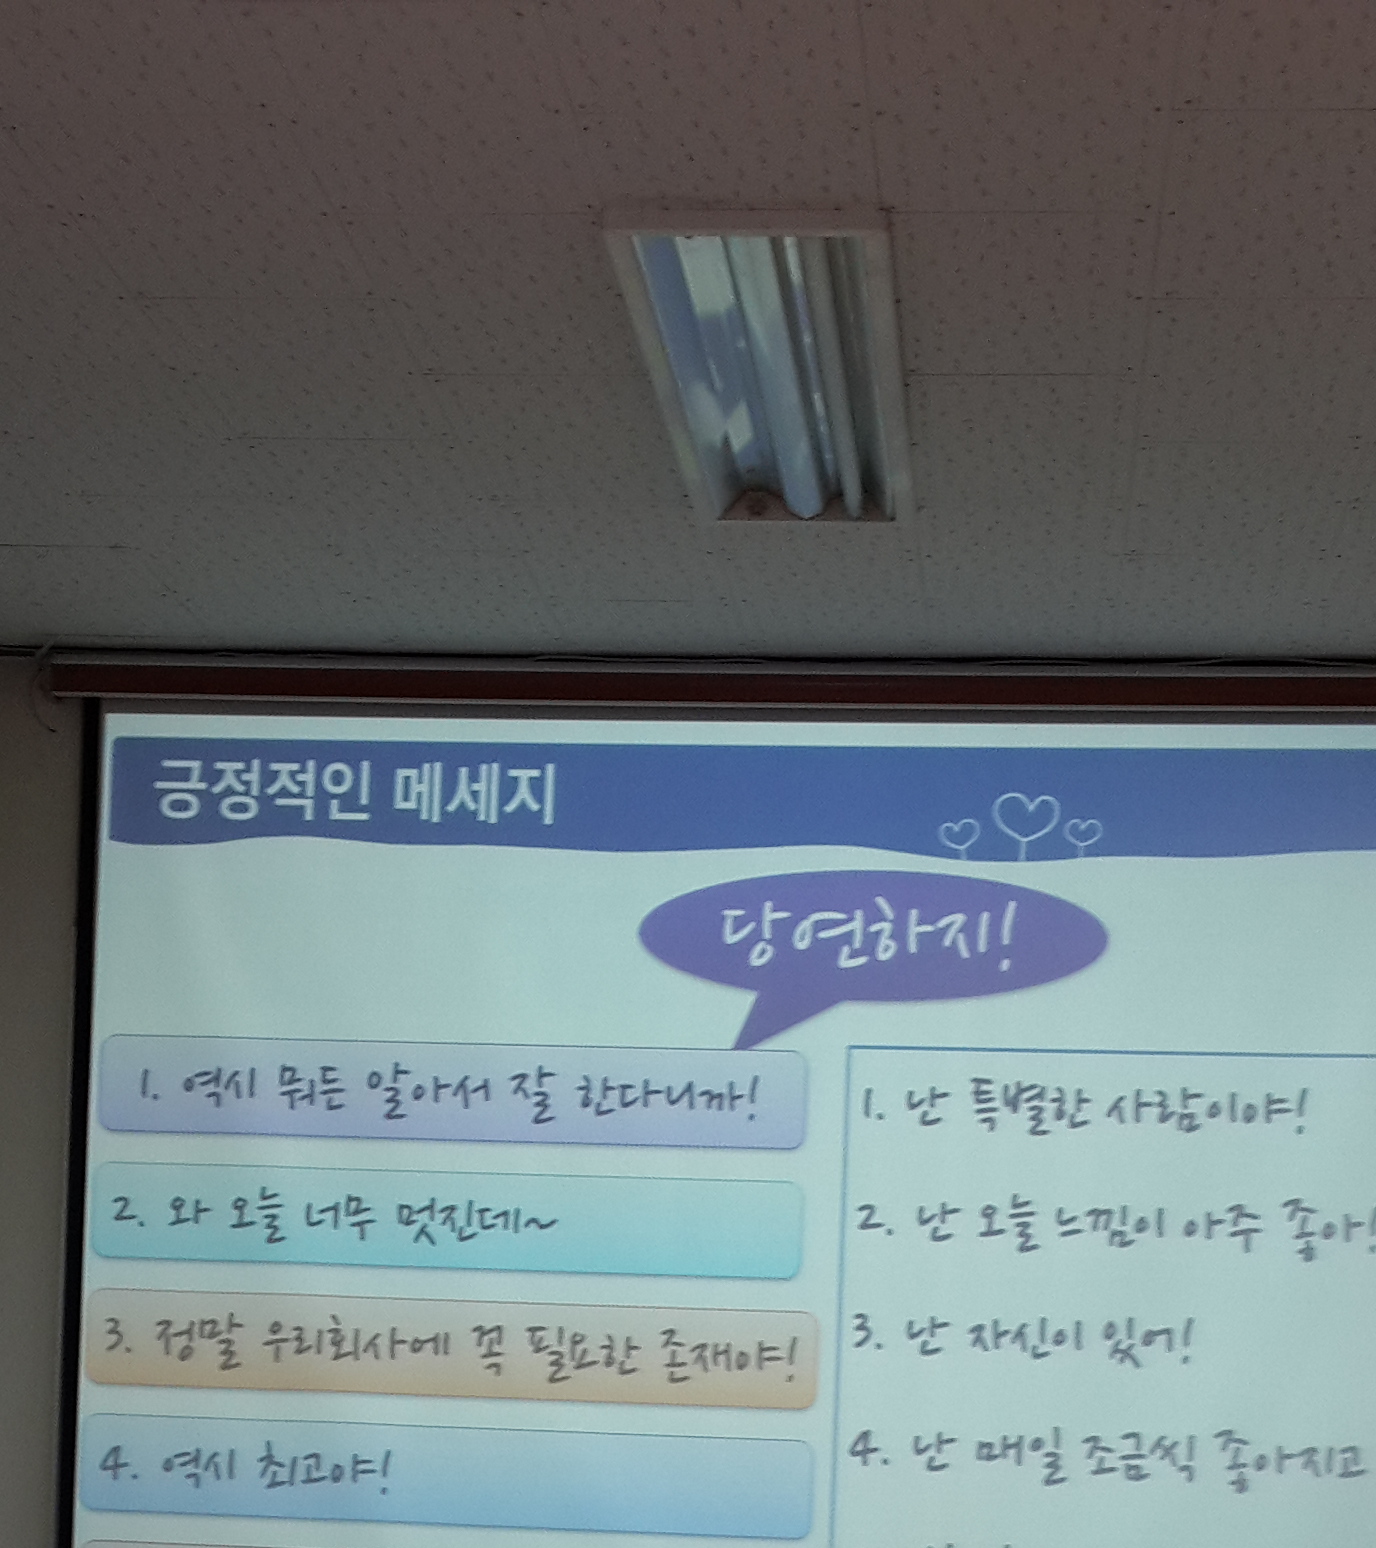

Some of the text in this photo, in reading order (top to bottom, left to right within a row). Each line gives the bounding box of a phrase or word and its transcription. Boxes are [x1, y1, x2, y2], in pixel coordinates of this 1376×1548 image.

[153, 758, 556, 825] 긍정적인 메세지
[723, 896, 1018, 972] 당연하지!
[140, 1061, 759, 1125] 1. 역시 뭐든 알아서 잘 한다니까!
[863, 1077, 1309, 1137] 1. 난 특별한 사람이야!
[112, 1186, 560, 1246] 2. 와 오늘 너무 멋진데~
[857, 1203, 893, 1236] 2.
[917, 1202, 962, 1243] 난
[979, 1193, 1040, 1254] 오늘
[1055, 1205, 1165, 1249] 느낌이
[1183, 1203, 1264, 1254] 아주
[104, 1312, 798, 1384] 3. 정말 우리회사에 꼭 필요한 존재야!
[854, 1312, 1195, 1369] 3. 난 자신이 있어!
[99, 1439, 392, 1496] 4. 역시 최고야!
[848, 1426, 1369, 1495] 4. 난 매일 조금씩 좋아지고
